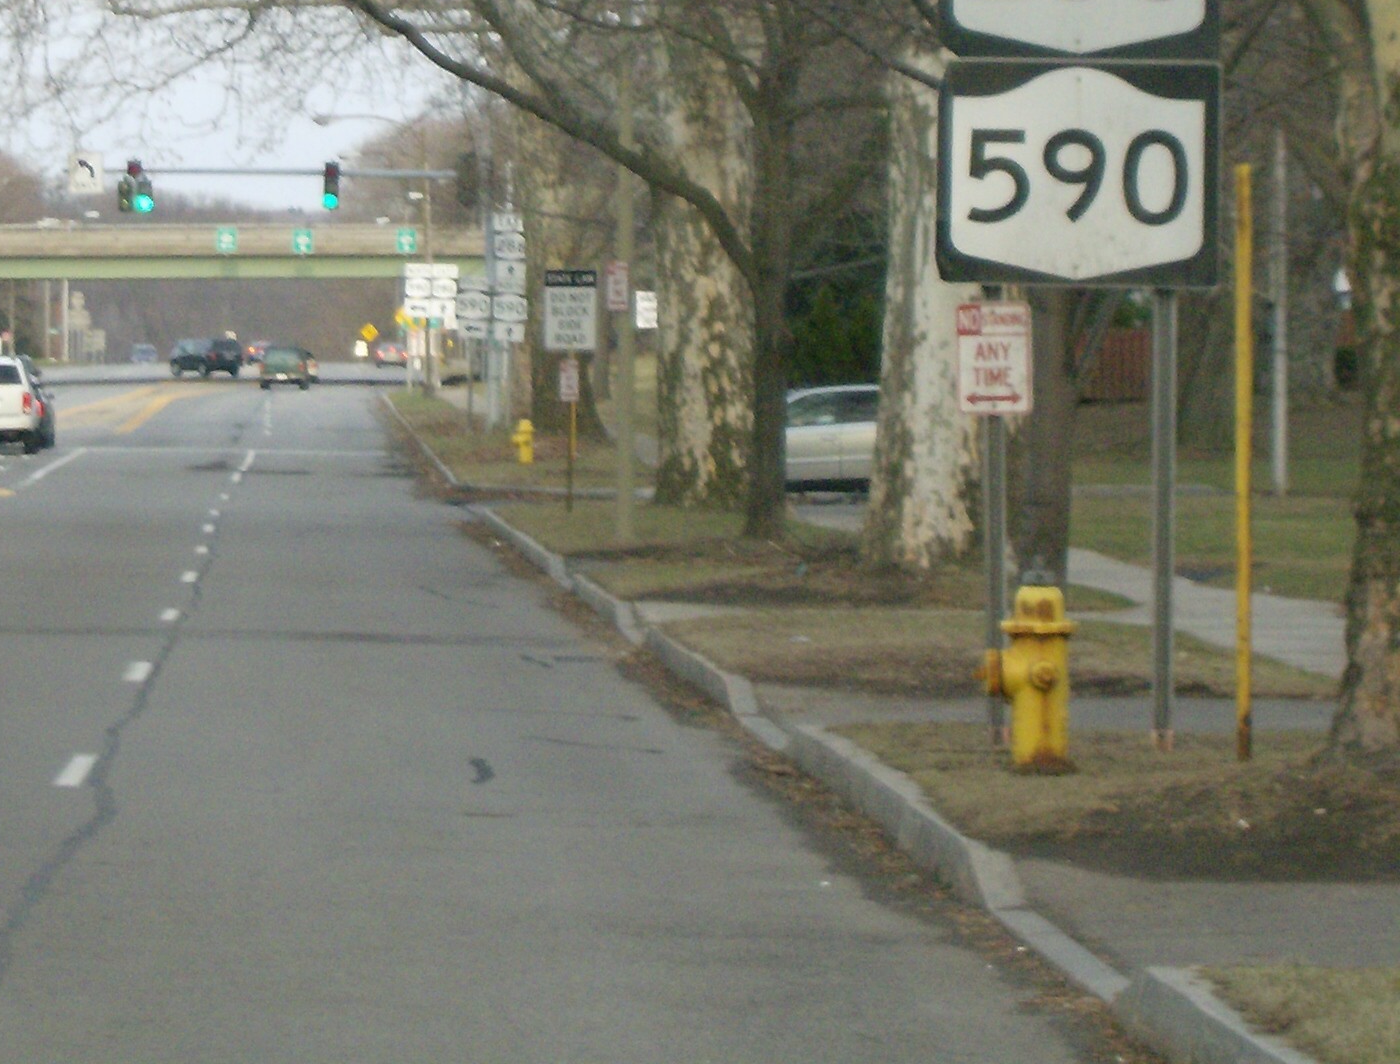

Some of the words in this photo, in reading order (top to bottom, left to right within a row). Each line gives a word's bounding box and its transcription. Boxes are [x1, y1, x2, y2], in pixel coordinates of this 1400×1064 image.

[967, 128, 1188, 226] 590
[458, 297, 488, 313] 590
[550, 291, 566, 302] DO
[569, 291, 591, 302] NOT
[495, 299, 526, 316] 590
[552, 305, 589, 317] BLOCK
[959, 309, 979, 329] NO
[554, 333, 586, 344] ROAD
[974, 342, 1011, 361] ANY
[973, 366, 1013, 387] TIME
